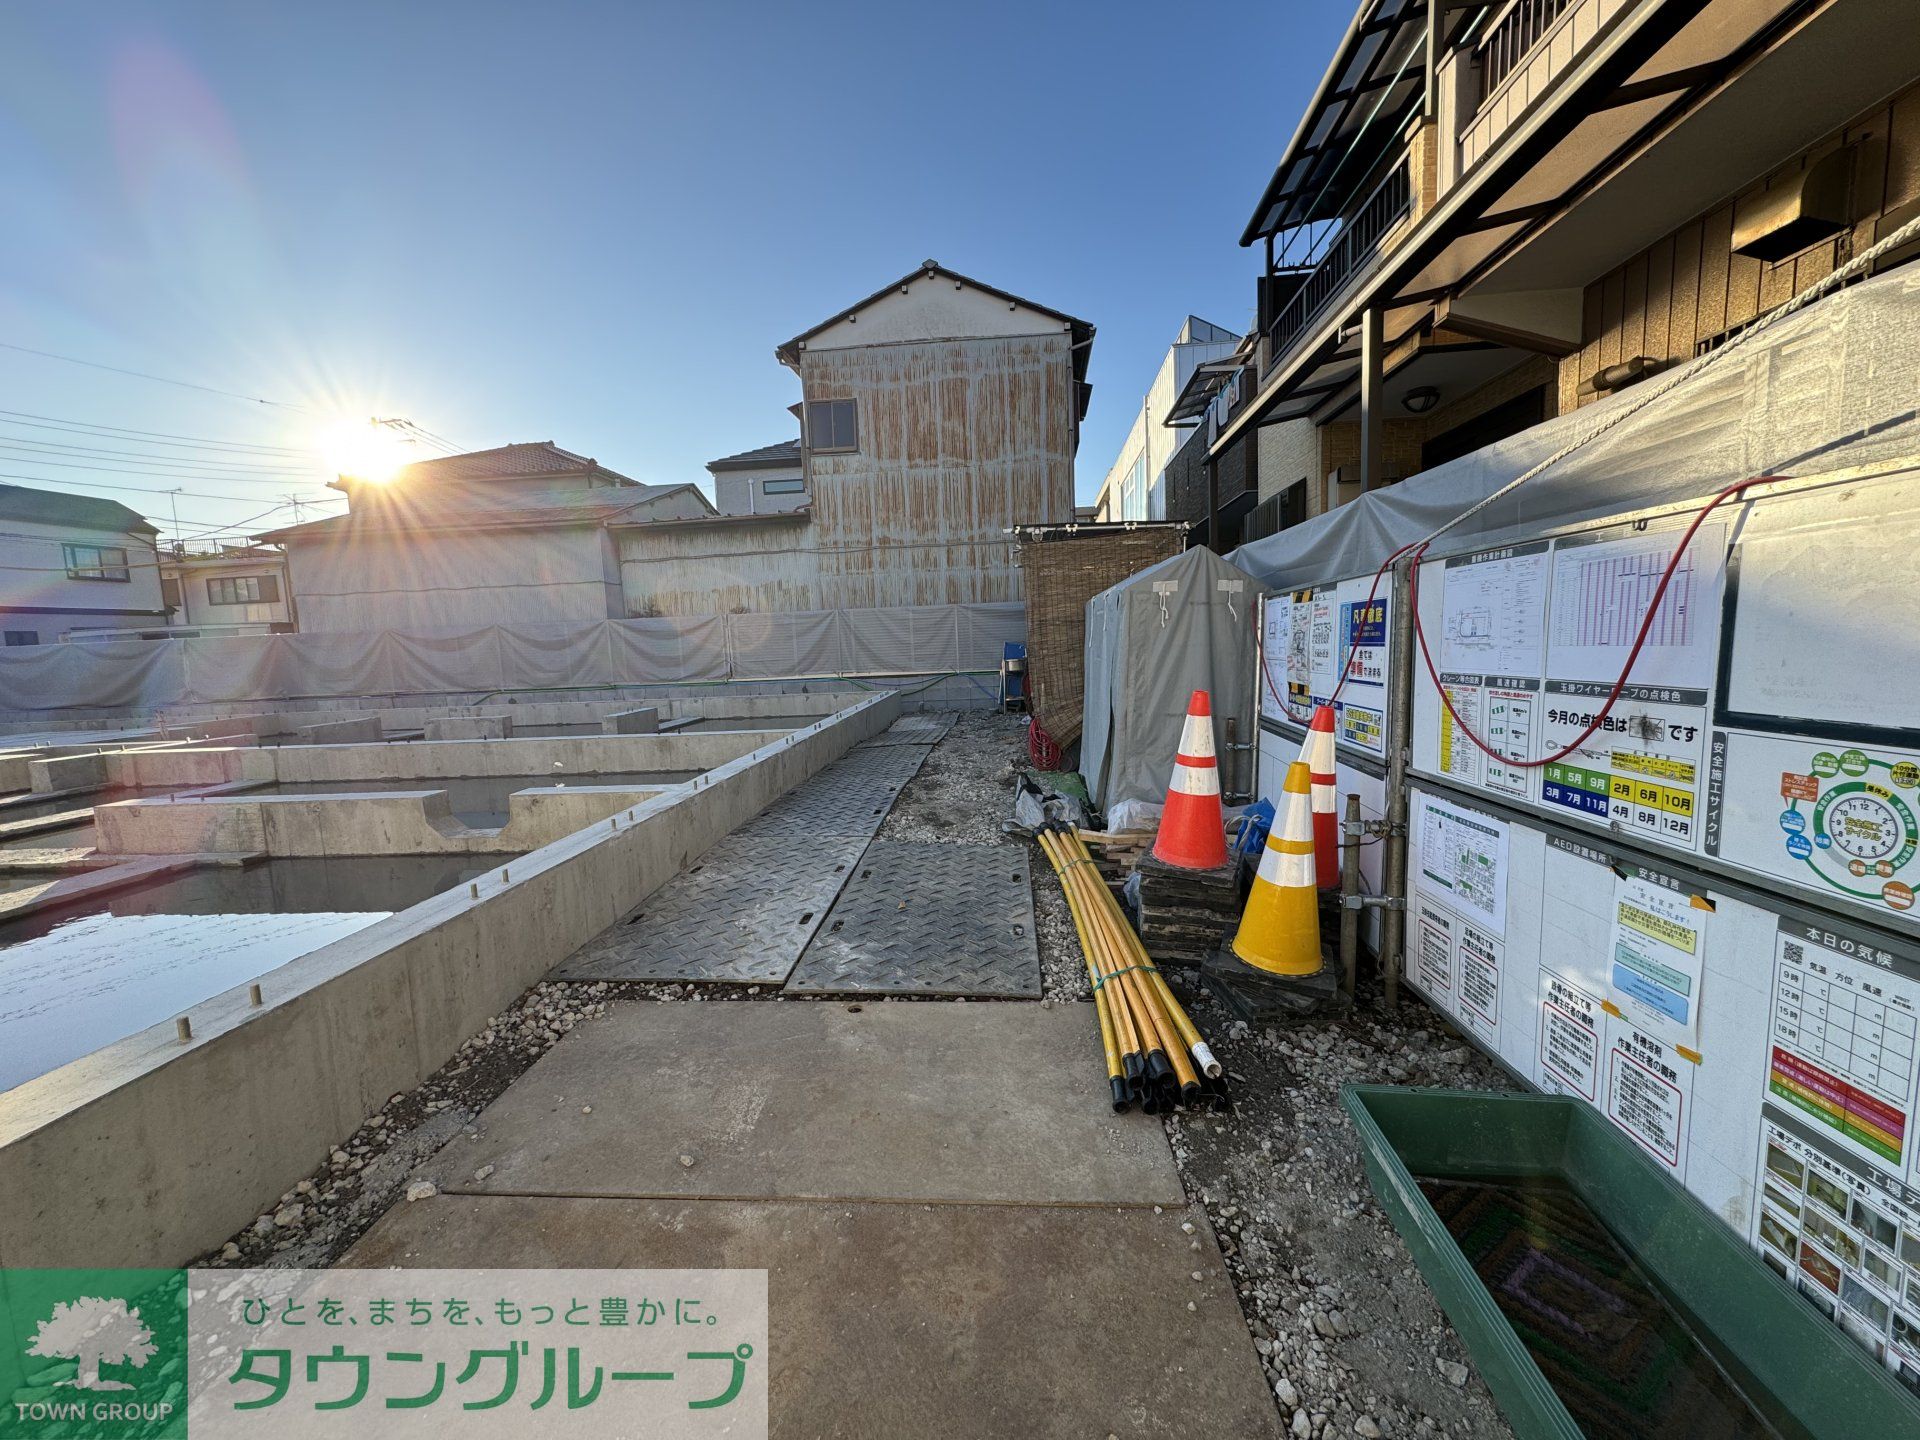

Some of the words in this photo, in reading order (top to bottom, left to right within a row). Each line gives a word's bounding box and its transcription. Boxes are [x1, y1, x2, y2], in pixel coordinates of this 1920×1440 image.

[1668, 725, 1698, 742] です
[1548, 767, 1561, 780] 1月
[1567, 771, 1582, 785] 5月
[1590, 776, 1606, 790] 9月
[1613, 783, 1630, 796] 2月
[1639, 789, 1658, 803] 6月
[1664, 794, 1691, 811] 10月
[1706, 742, 1725, 846] 安全施工サイクル
[1866, 785, 1889, 798] 昼休み
[1546, 786, 1560, 799] 3月
[1567, 791, 1581, 806] 7月
[1586, 797, 1607, 812] 11月
[1613, 804, 1629, 818] 4月
[1638, 812, 1656, 826] 8月
[1663, 817, 1689, 835] 12月
[1860, 803, 1870, 811] 12
[1844, 817, 1884, 832] 安全施工
[1844, 827, 1882, 841] サイクル
[1553, 838, 1607, 864] AED設置場所
[1639, 867, 1679, 891] 安全宣言
[1806, 927, 1893, 968] 本日の気候
[1783, 970, 1799, 982] 9時
[1809, 962, 1827, 975] 気温
[1835, 973, 1854, 986] 方位
[1863, 982, 1882, 997] 風速
[1551, 980, 1592, 1013] 鉄骨の組立て等
[1781, 988, 1800, 1002] 12時
[1548, 991, 1594, 1029] 作業主任者の職務
[1779, 1006, 1798, 1020] 15時
[1778, 1023, 1796, 1038] 18時
[1633, 1031, 1662, 1058] 有機溶剤
[1617, 1036, 1677, 1084] 作業主任者の職務
[1768, 1124, 1802, 1152] 工場デポ
[1804, 1148, 1871, 1196] 分別基準（写真）
